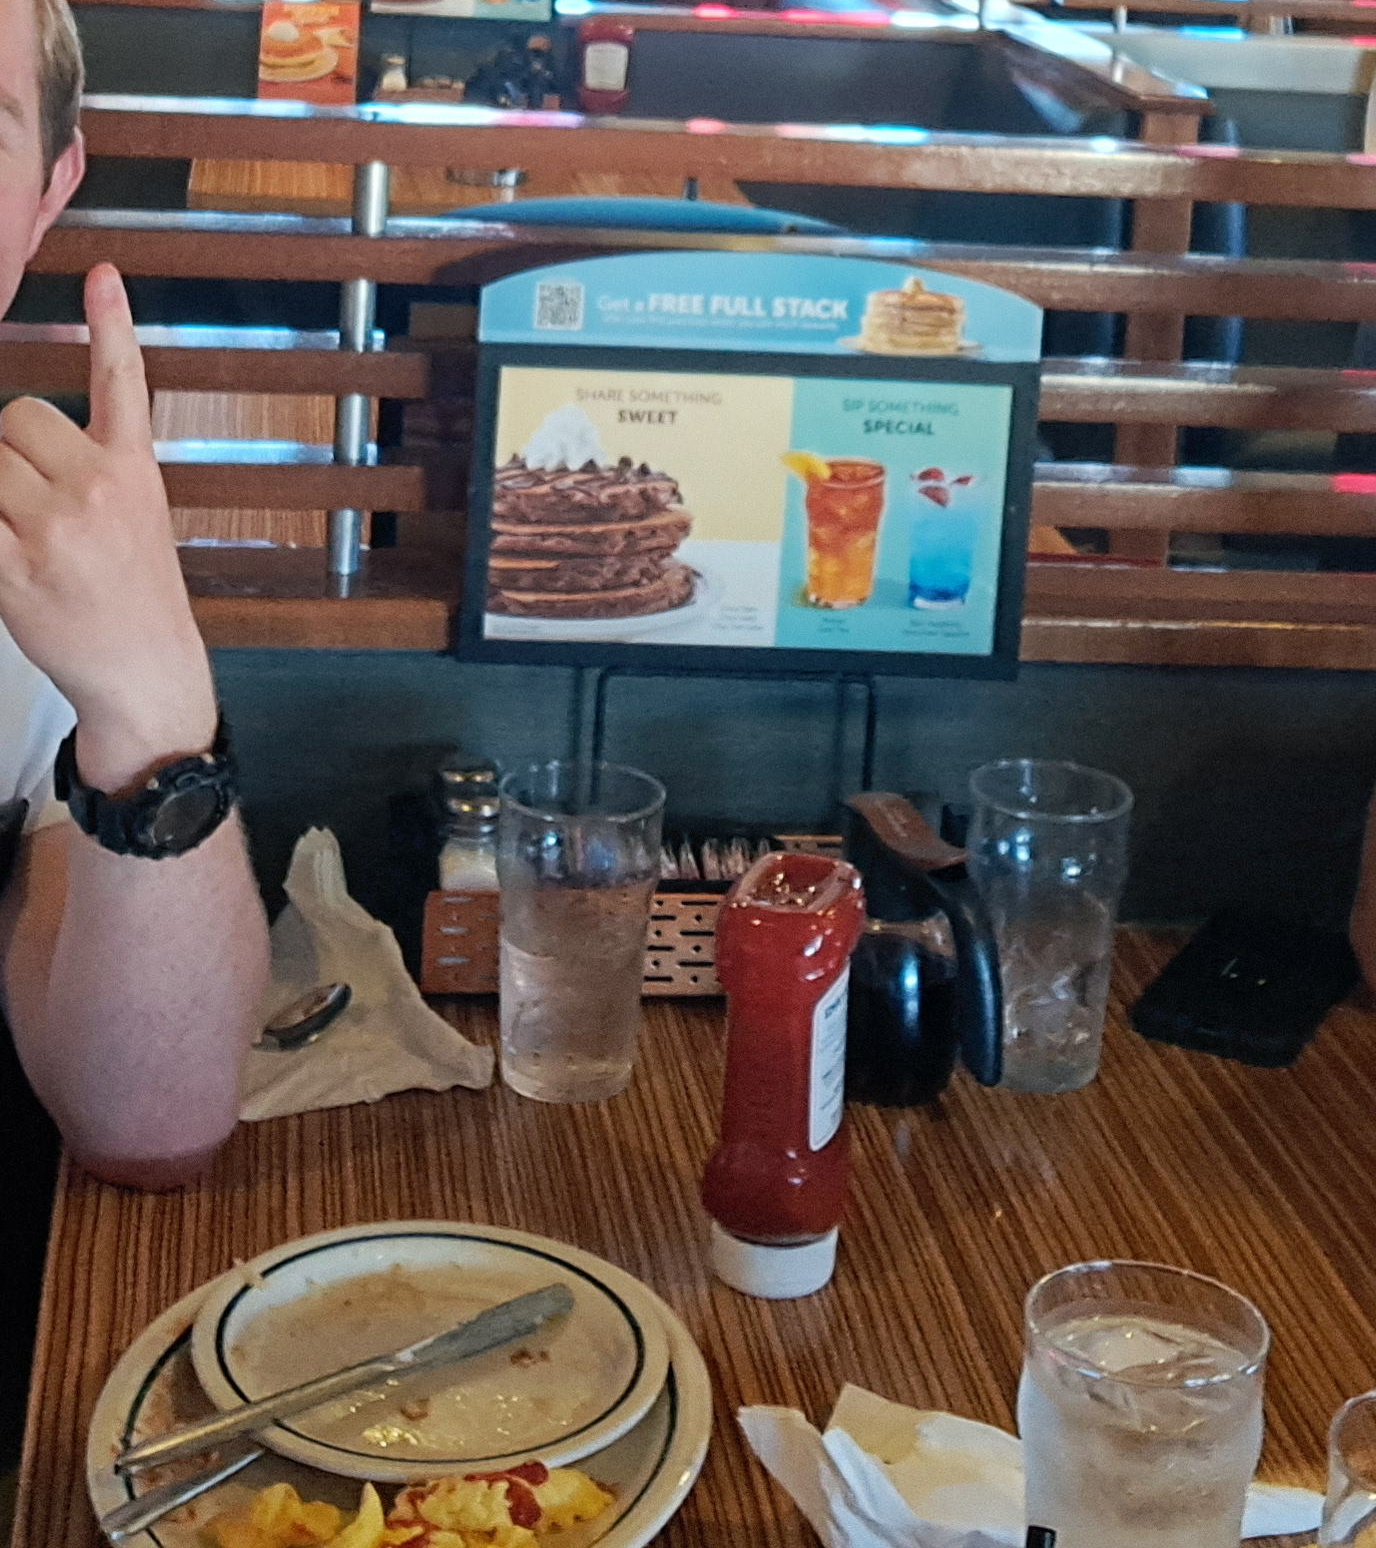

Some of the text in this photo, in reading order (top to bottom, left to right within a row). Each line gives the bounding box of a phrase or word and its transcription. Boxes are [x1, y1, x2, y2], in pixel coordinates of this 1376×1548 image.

[648, 293, 706, 315] FREE
[710, 295, 767, 318] FULL
[771, 297, 849, 321] STACK
[576, 388, 722, 406] SHARE SOMETHING
[618, 409, 678, 425] SWEET
[868, 399, 960, 417] SOMETHING
[863, 418, 934, 436] SPECIAL
